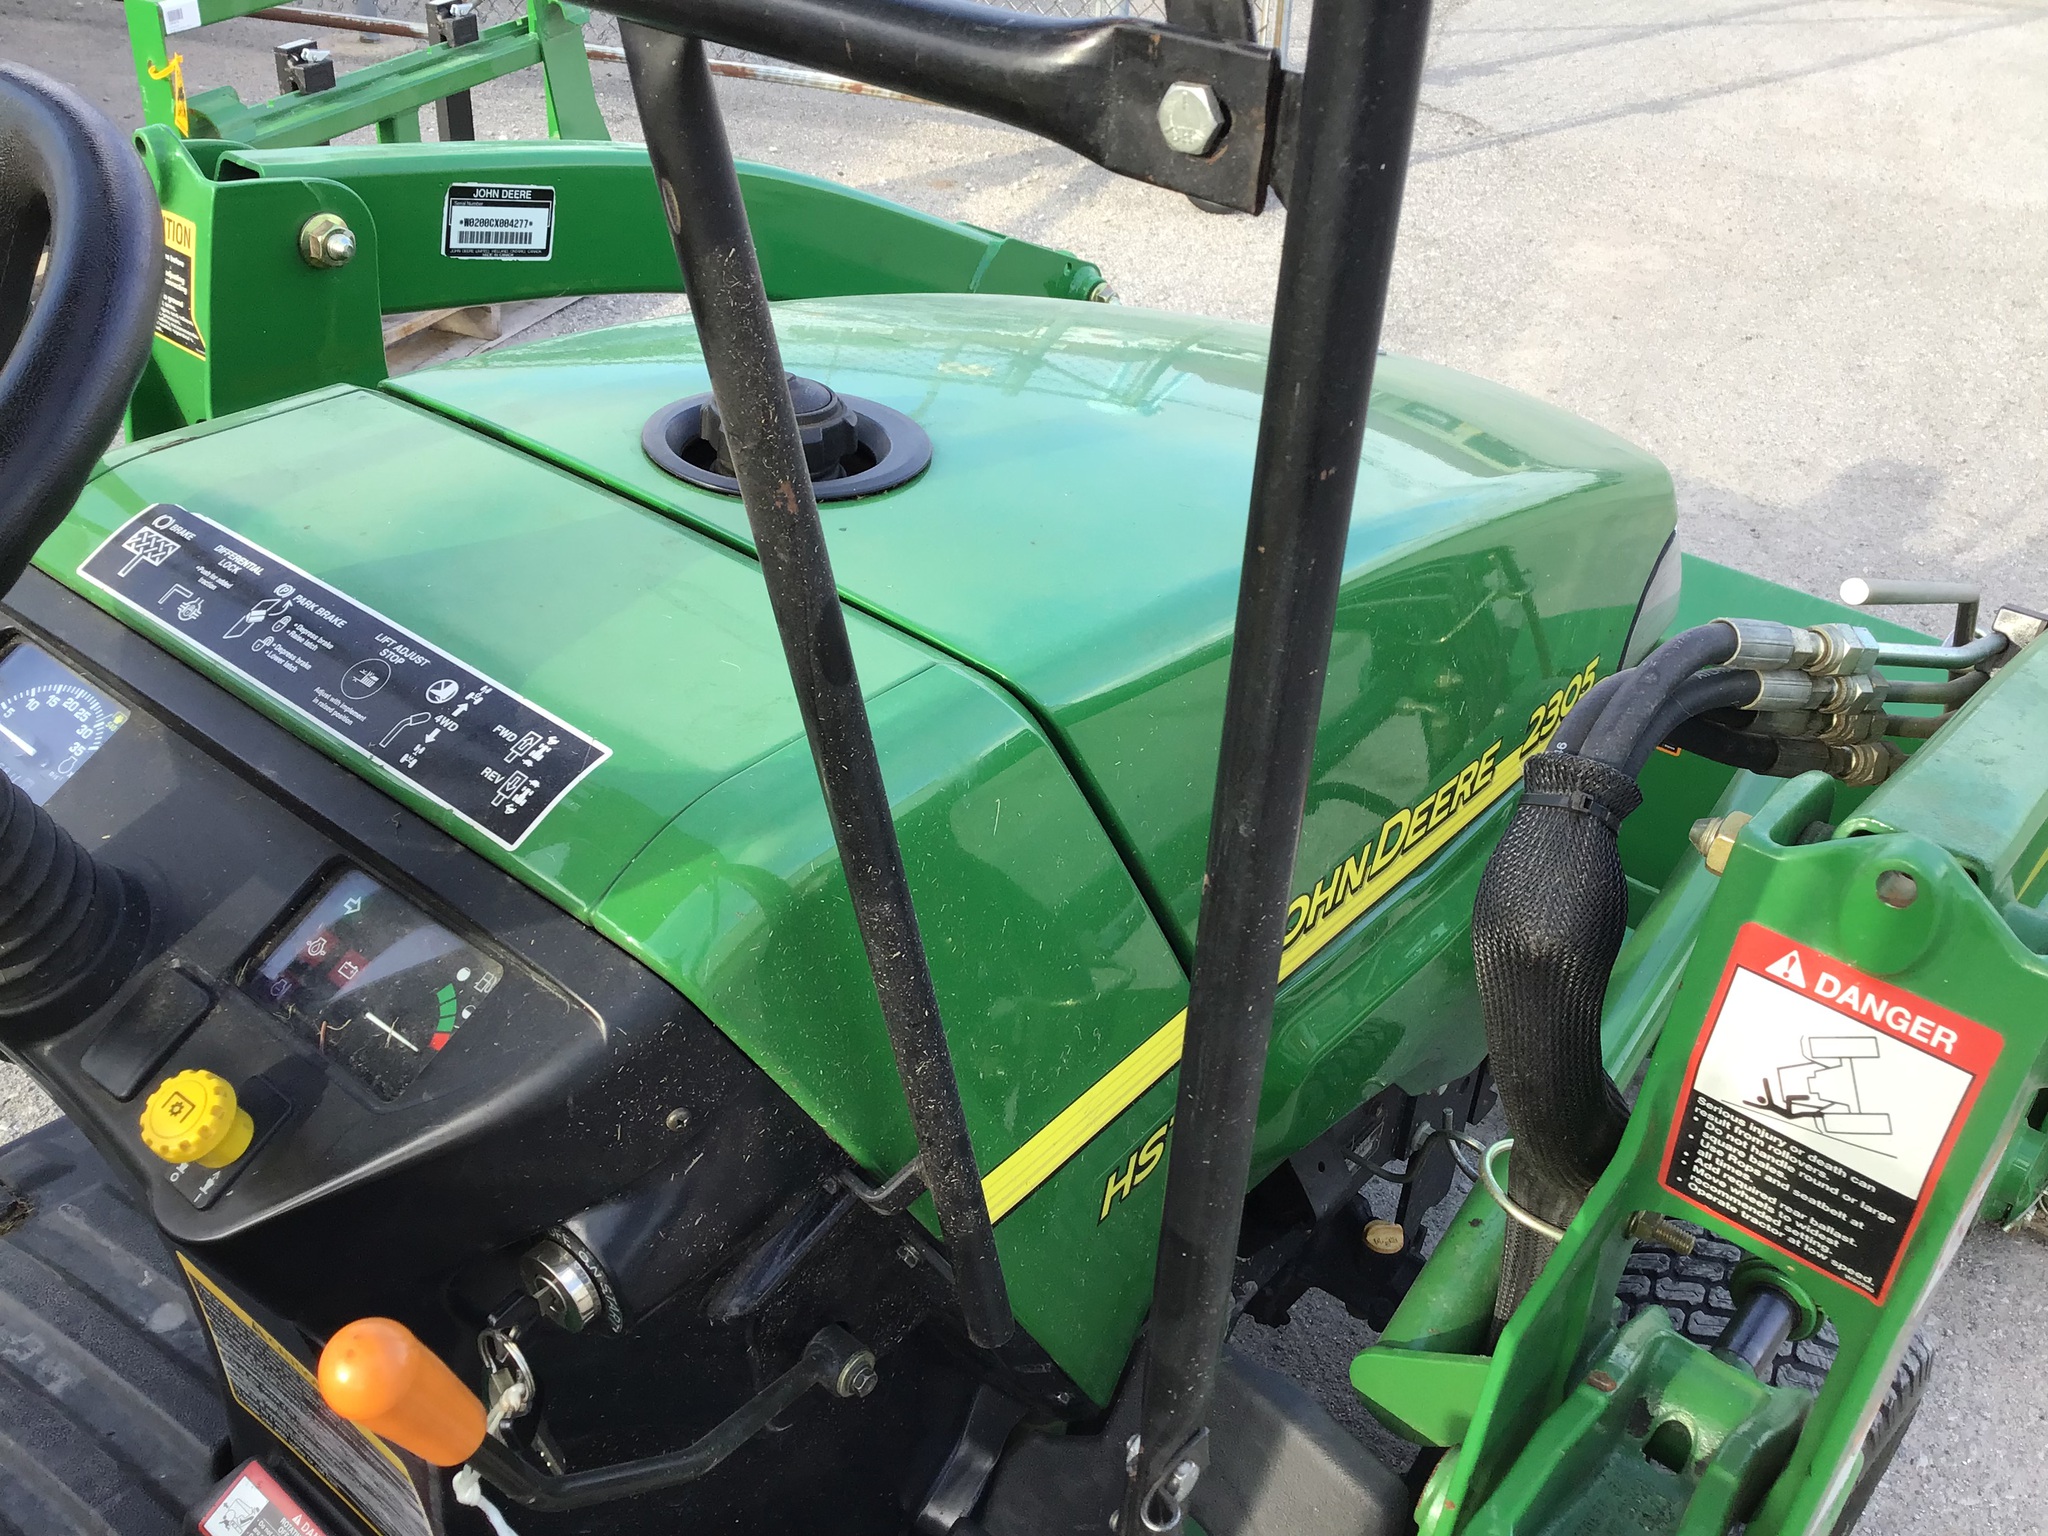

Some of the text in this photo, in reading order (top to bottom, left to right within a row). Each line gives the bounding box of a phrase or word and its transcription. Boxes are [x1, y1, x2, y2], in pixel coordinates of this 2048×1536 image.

[473, 188, 532, 200] JOHN DEERE
[164, 216, 191, 249] TION
[169, 524, 196, 541] BRAKE
[214, 544, 264, 576] DIFFERENTIAL
[218, 559, 242, 574] LOCK
[292, 594, 348, 628] PARK BRAKE
[296, 624, 334, 650] Depress brake
[303, 639, 318, 652] latch
[374, 632, 430, 666] LIFT ADJUST
[267, 650, 298, 673] Lower latch
[274, 644, 312, 670] Depress brake
[380, 648, 406, 664] STOP
[3, 708, 16, 718] 5
[25, 698, 40, 712] 10
[46, 694, 60, 708] 15
[62, 697, 80, 712] 20
[74, 708, 92, 722] 25
[314, 686, 366, 722] Adjust with implement
[317, 700, 334, 714] raised
[331, 708, 354, 726] position
[1519, 653, 1600, 760] 2305
[76, 724, 94, 740] 30
[434, 714, 458, 732] 4WD
[492, 724, 518, 742] FWD
[68, 742, 86, 756] 35
[480, 767, 505, 784] REV
[1282, 737, 1503, 948] OHN DEERE
[1814, 971, 1958, 1055] DANGER
[1694, 1107, 1830, 1181] result from rollovers.
[1697, 1096, 1876, 1193] Serious injury or death can
[1702, 1131, 1788, 1180] square bales.
[1097, 1114, 1175, 1226] HS
[1697, 1149, 1754, 1183] all times.
[1704, 1121, 1896, 1224] Do not handle round or large
[1700, 1138, 1866, 1230] Use Rops and seatbelt at
[1690, 1174, 1833, 1254] recommended setting.
[1692, 1164, 1840, 1248] Move wheels to widest
[1694, 1157, 1858, 1248] Add required rear ballast.
[1688, 1182, 1874, 1286] Operate tractor at low speed.
[578, 1250, 602, 1278] ON
